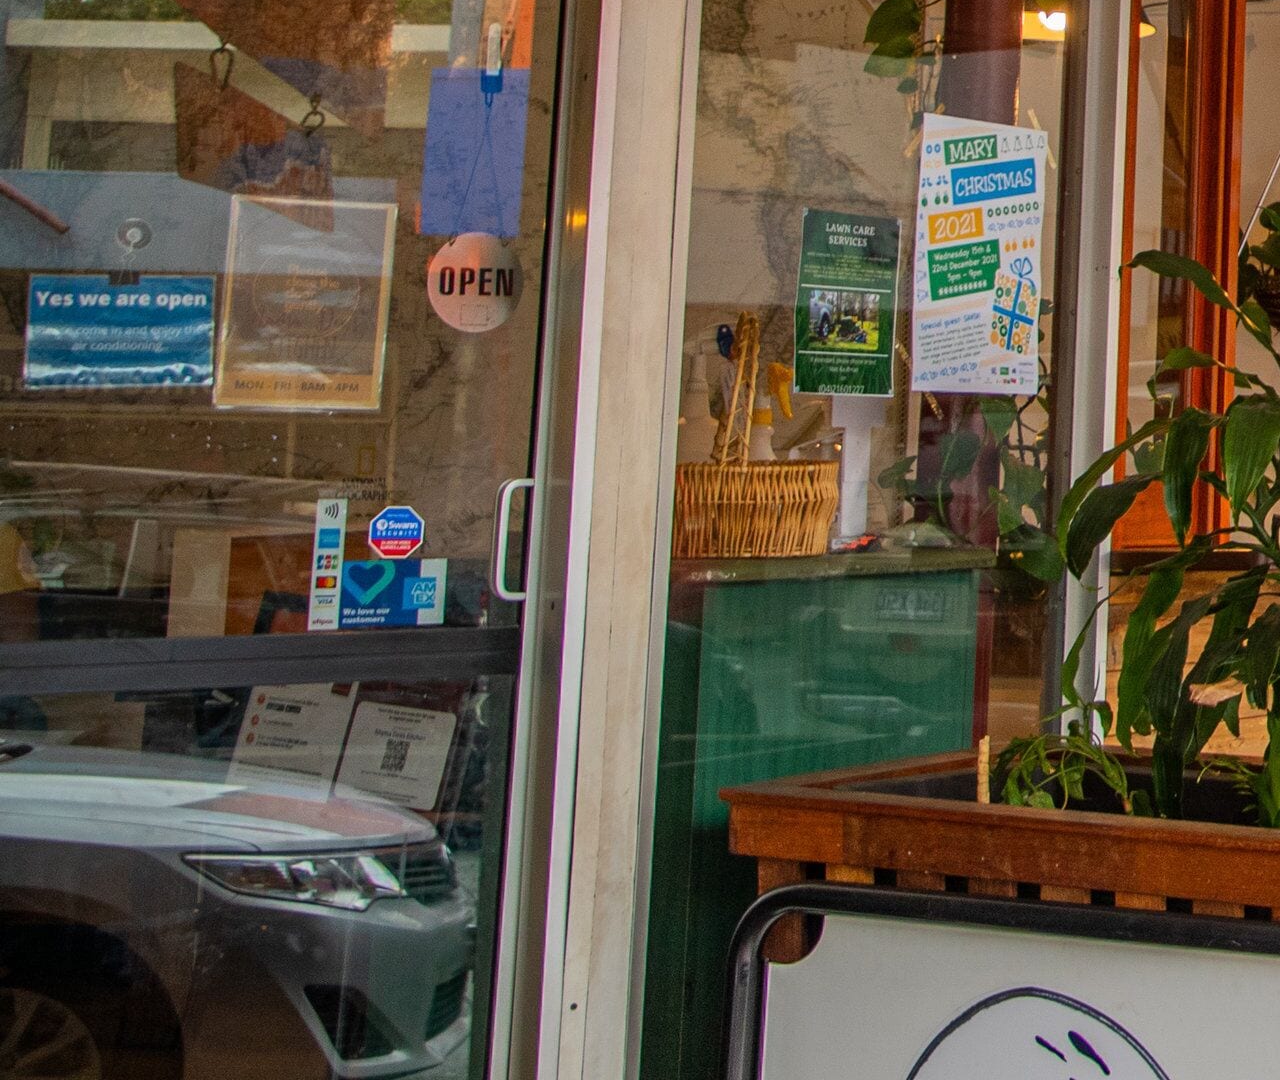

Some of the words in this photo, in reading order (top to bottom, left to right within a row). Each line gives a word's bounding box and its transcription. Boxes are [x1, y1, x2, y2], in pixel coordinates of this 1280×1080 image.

[949, 137, 996, 163] MARY
[955, 168, 1033, 197] CHRISTMAS
[826, 223, 851, 234] LAWN
[853, 225, 876, 236] CARE
[935, 212, 977, 239] 2021
[828, 235, 868, 247] SERVICES
[933, 249, 970, 261] Wednesday
[932, 263, 948, 273] 22nd
[949, 259, 980, 270] December
[982, 254, 998, 265] 2021
[439, 266, 514, 297] OPEN
[36, 291, 74, 306] Yes
[79, 294, 111, 306] we
[116, 294, 150, 306] are
[156, 294, 207, 310] open
[388, 520, 418, 529] Swann
[342, 608, 356, 616] We
[358, 607, 375, 615] love
[342, 616, 386, 624] customers
